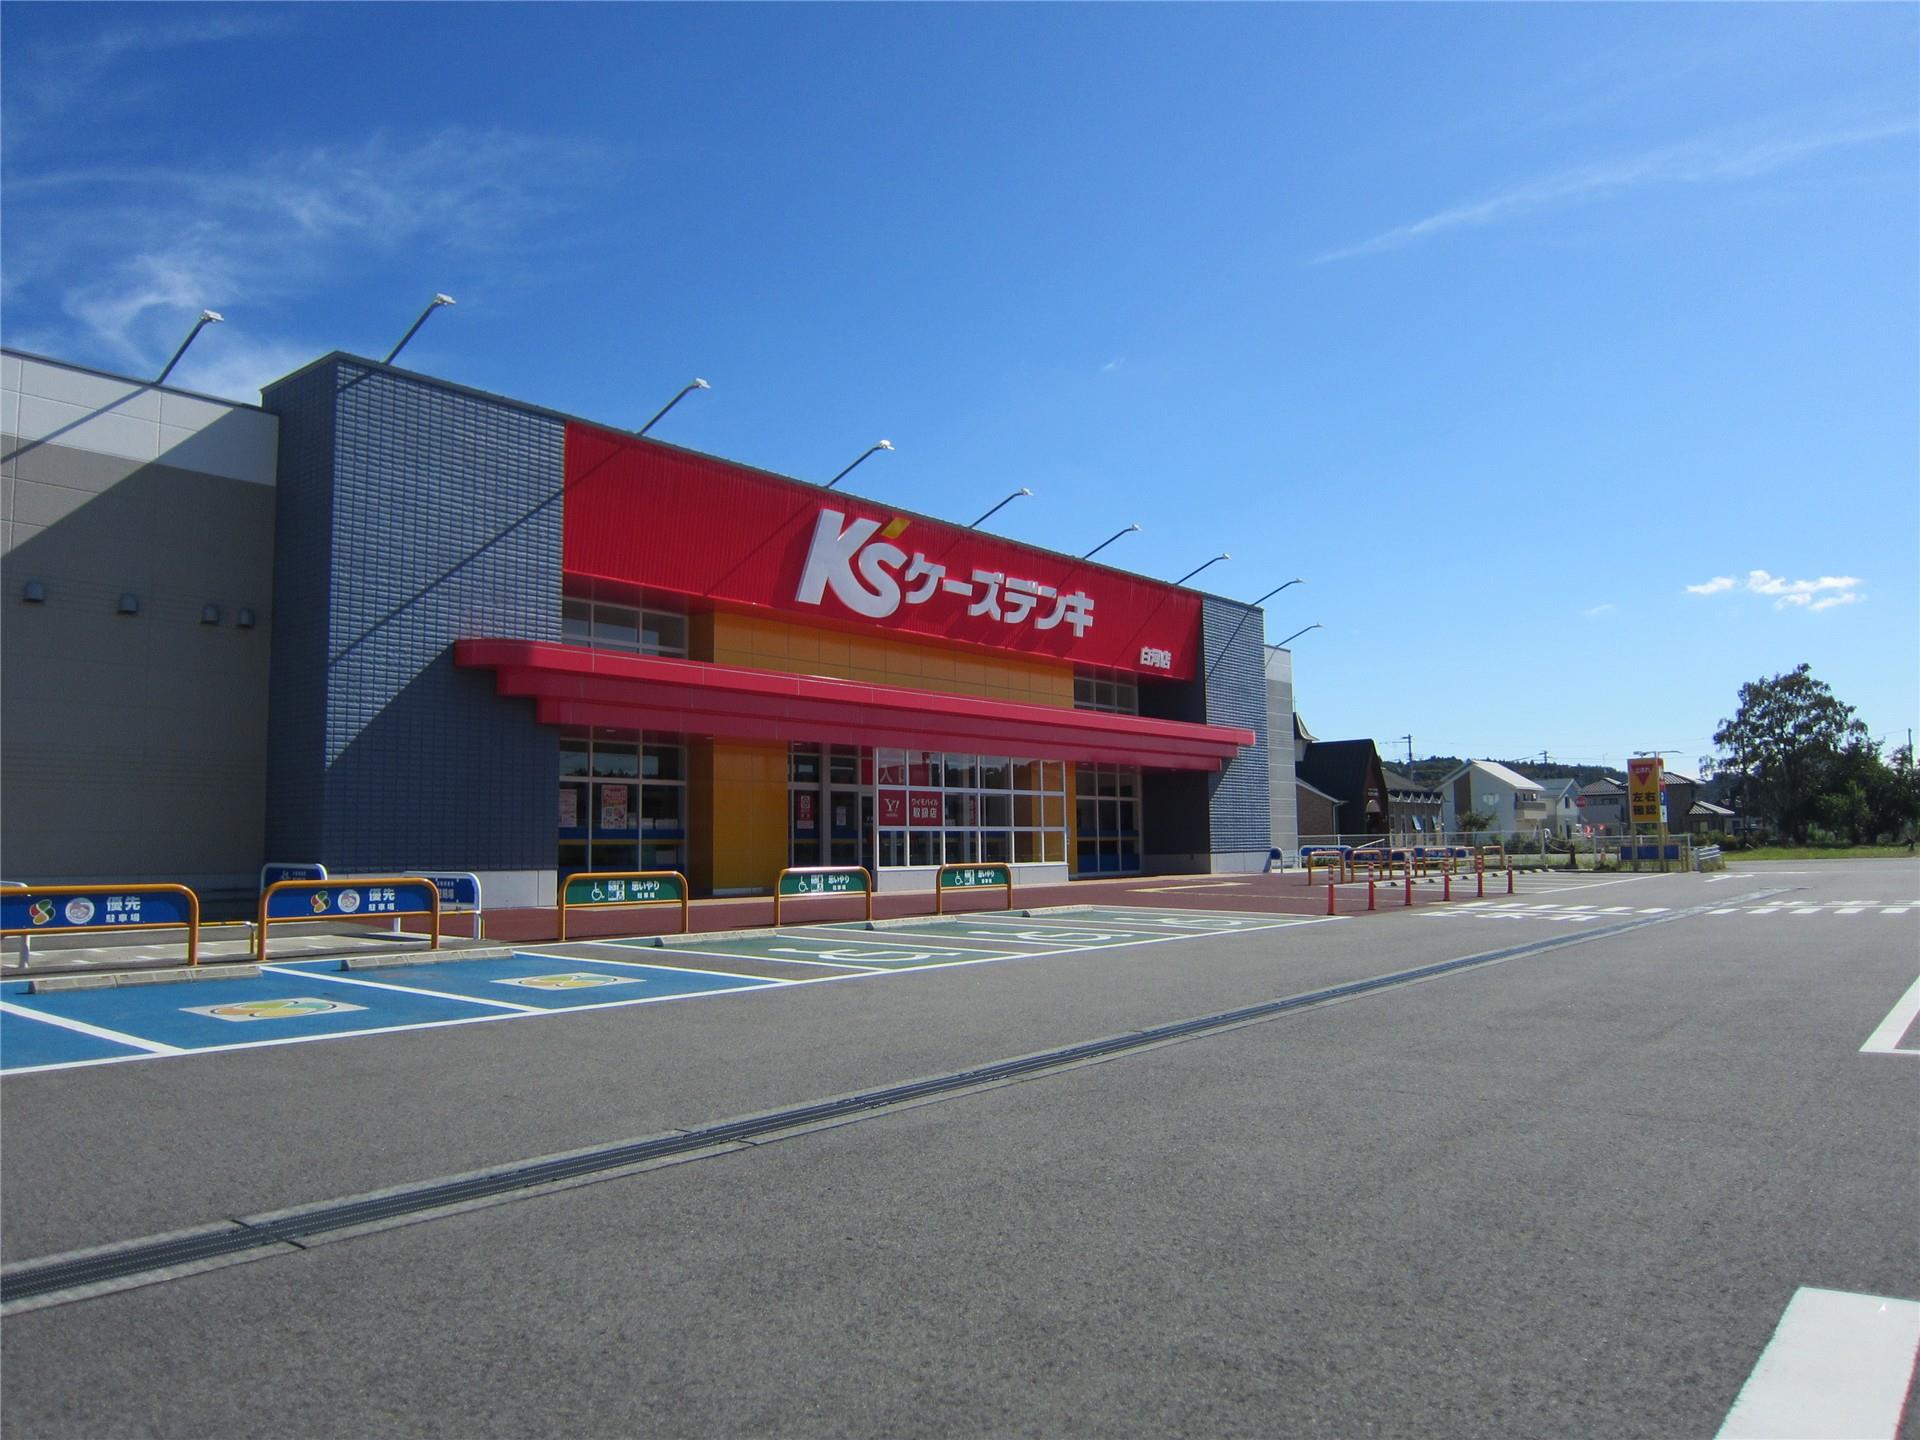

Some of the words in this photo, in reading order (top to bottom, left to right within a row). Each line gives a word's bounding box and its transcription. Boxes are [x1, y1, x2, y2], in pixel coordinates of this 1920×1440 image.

[795, 508, 911, 618] K's
[904, 552, 1095, 638] ケーズデンキ
[1140, 646, 1171, 669] 白河店
[1632, 791, 1656, 802] 左右
[631, 880, 660, 892] 思いやり
[368, 887, 396, 902] 優先
[106, 896, 141, 912] 優先
[368, 903, 395, 912] 駐車場
[105, 913, 140, 923] 駐車場
